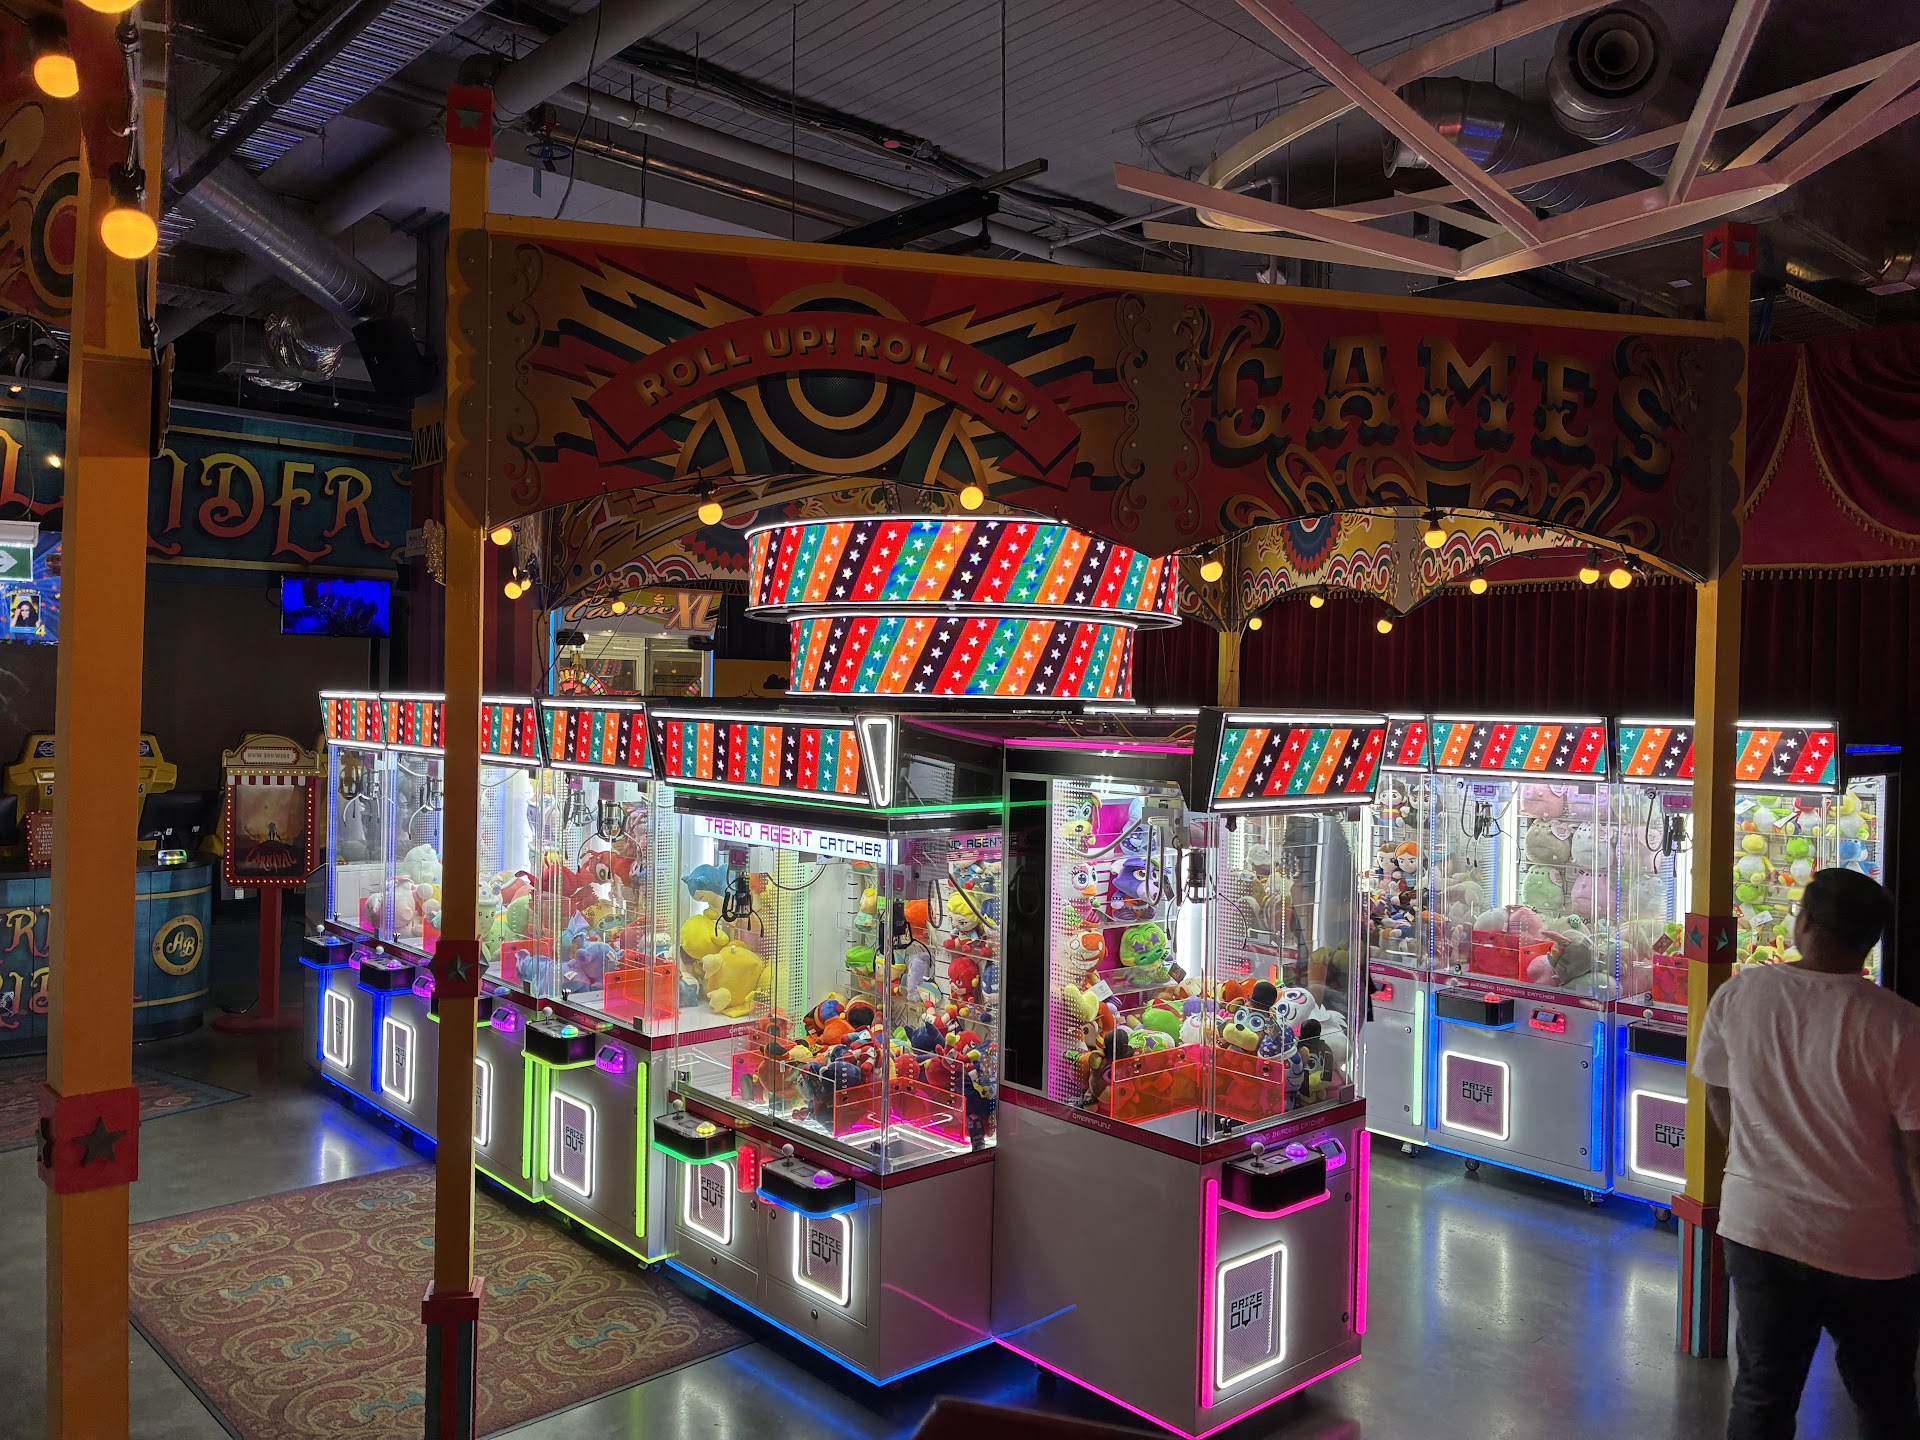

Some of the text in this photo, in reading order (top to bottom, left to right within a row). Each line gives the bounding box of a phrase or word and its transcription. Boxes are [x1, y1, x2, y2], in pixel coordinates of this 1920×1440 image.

[634, 324, 1041, 430] ROLL UP! ROLL UP!
[1203, 335, 1673, 491] GAMES
[148, 447, 391, 563] IDER
[664, 592, 714, 632] XL
[46, 785, 53, 796] 5
[705, 817, 882, 858] TREND AGENT CATCHER
[1527, 991, 1556, 1001] CATCHER
[1673, 1014, 1687, 1022] TRE
[1462, 1081, 1493, 1093] PRIZE
[1462, 1088, 1493, 1104] OUT
[565, 1126, 584, 1141] PRIZE
[1655, 1123, 1685, 1136] PRIZ
[565, 1134, 584, 1153] OUT
[701, 1175, 725, 1195] PRIZE
[701, 1186, 724, 1209] OUT
[811, 1229, 842, 1251] PRIZE
[811, 1240, 842, 1266] OUT
[1231, 1291, 1263, 1313] PRIZE
[1230, 1302, 1262, 1330] OUT
